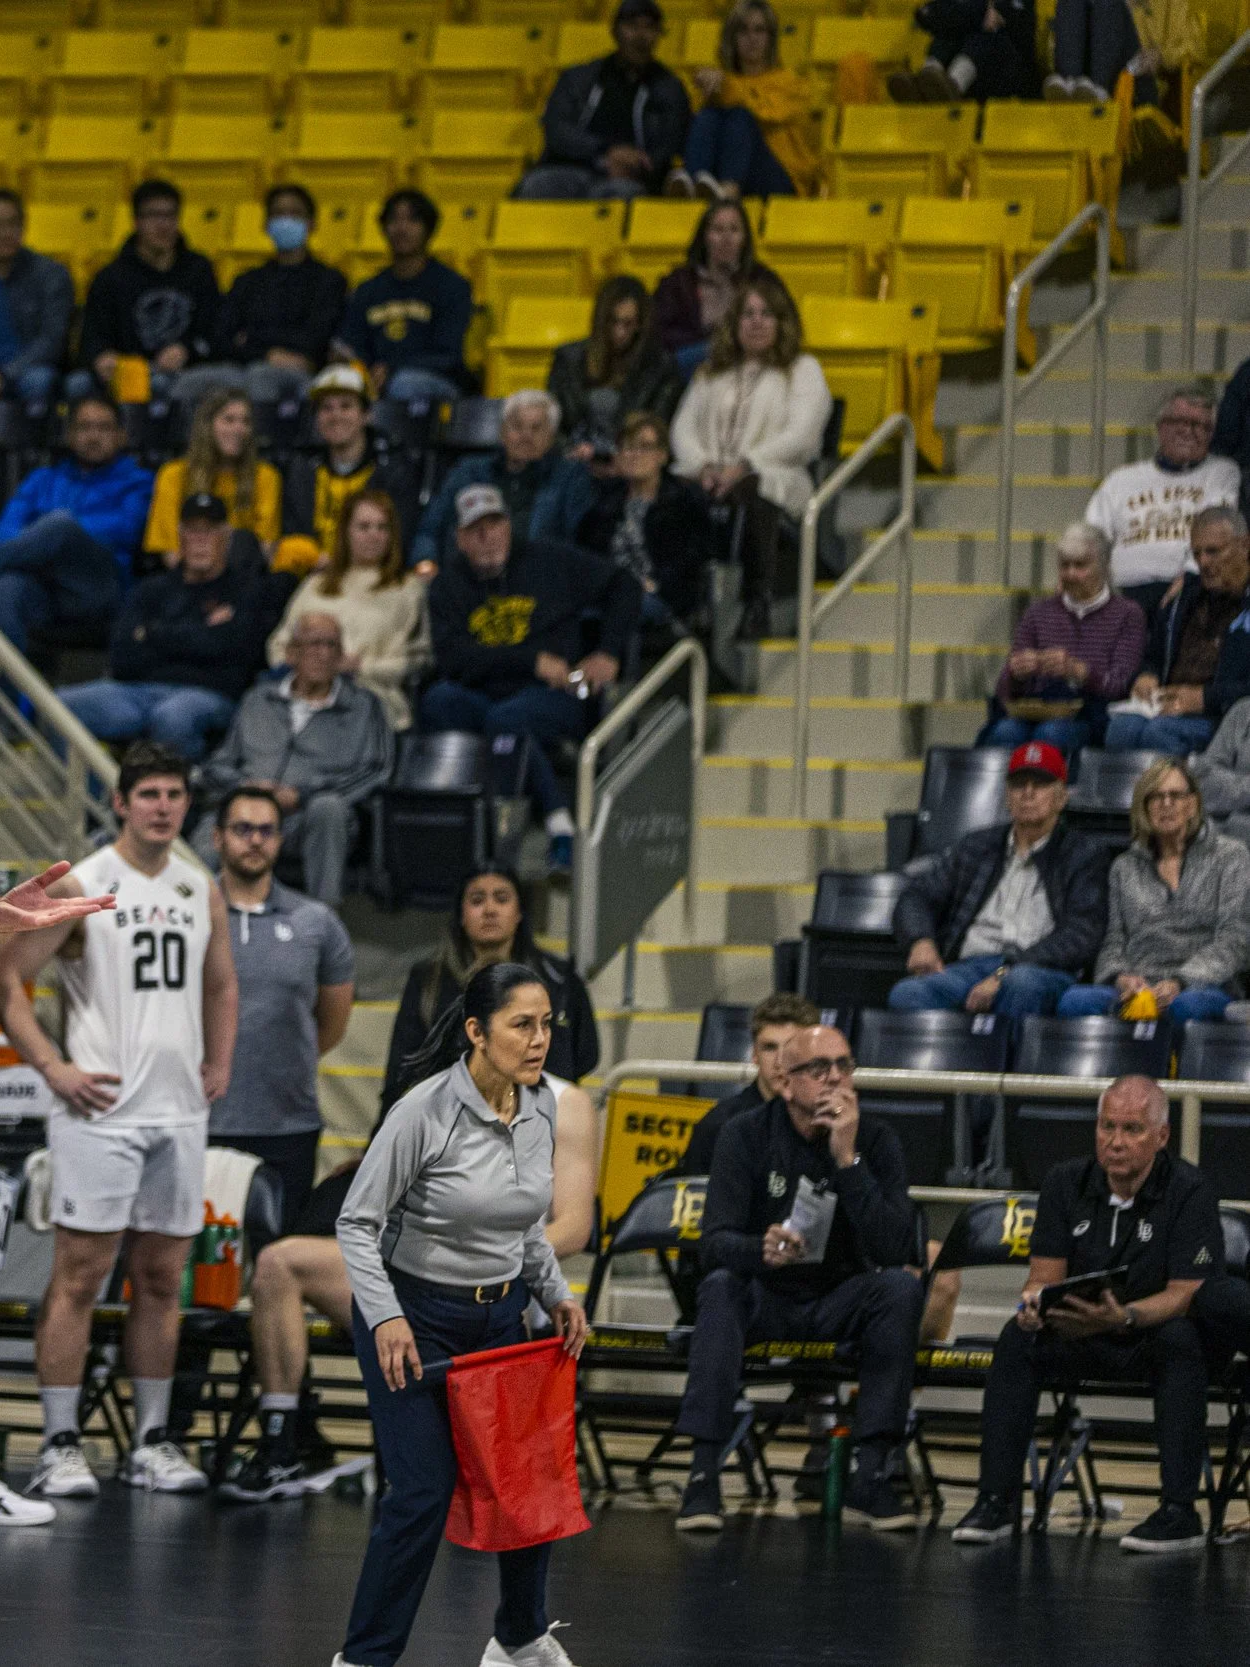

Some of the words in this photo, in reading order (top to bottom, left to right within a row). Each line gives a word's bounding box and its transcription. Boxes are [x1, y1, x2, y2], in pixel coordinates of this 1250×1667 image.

[115, 905, 195, 930] BEACH
[133, 930, 187, 991] 20
[626, 1114, 690, 1139] SECT
[636, 1146, 680, 1166] RO
